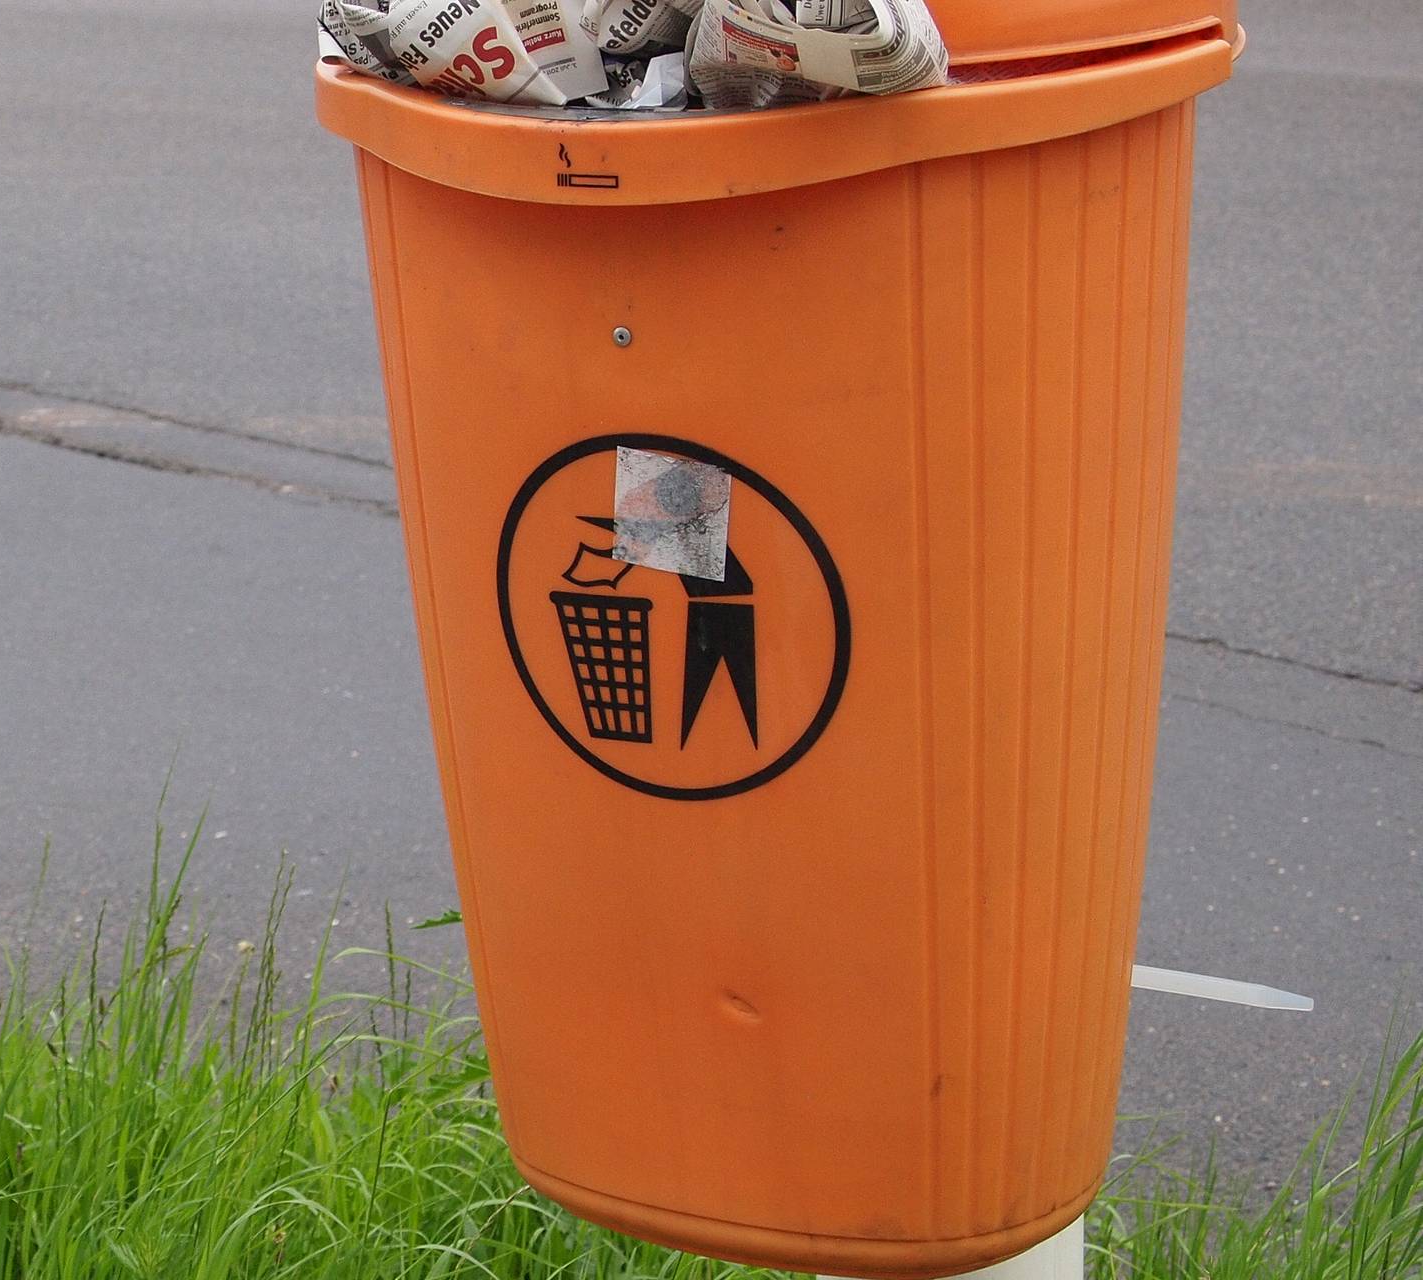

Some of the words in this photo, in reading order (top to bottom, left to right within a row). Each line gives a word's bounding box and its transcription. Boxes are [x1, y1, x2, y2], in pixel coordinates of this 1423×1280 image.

[519, 1, 558, 18] Programm
[419, 0, 481, 48] Neues
[540, 29, 563, 40] Kurz
